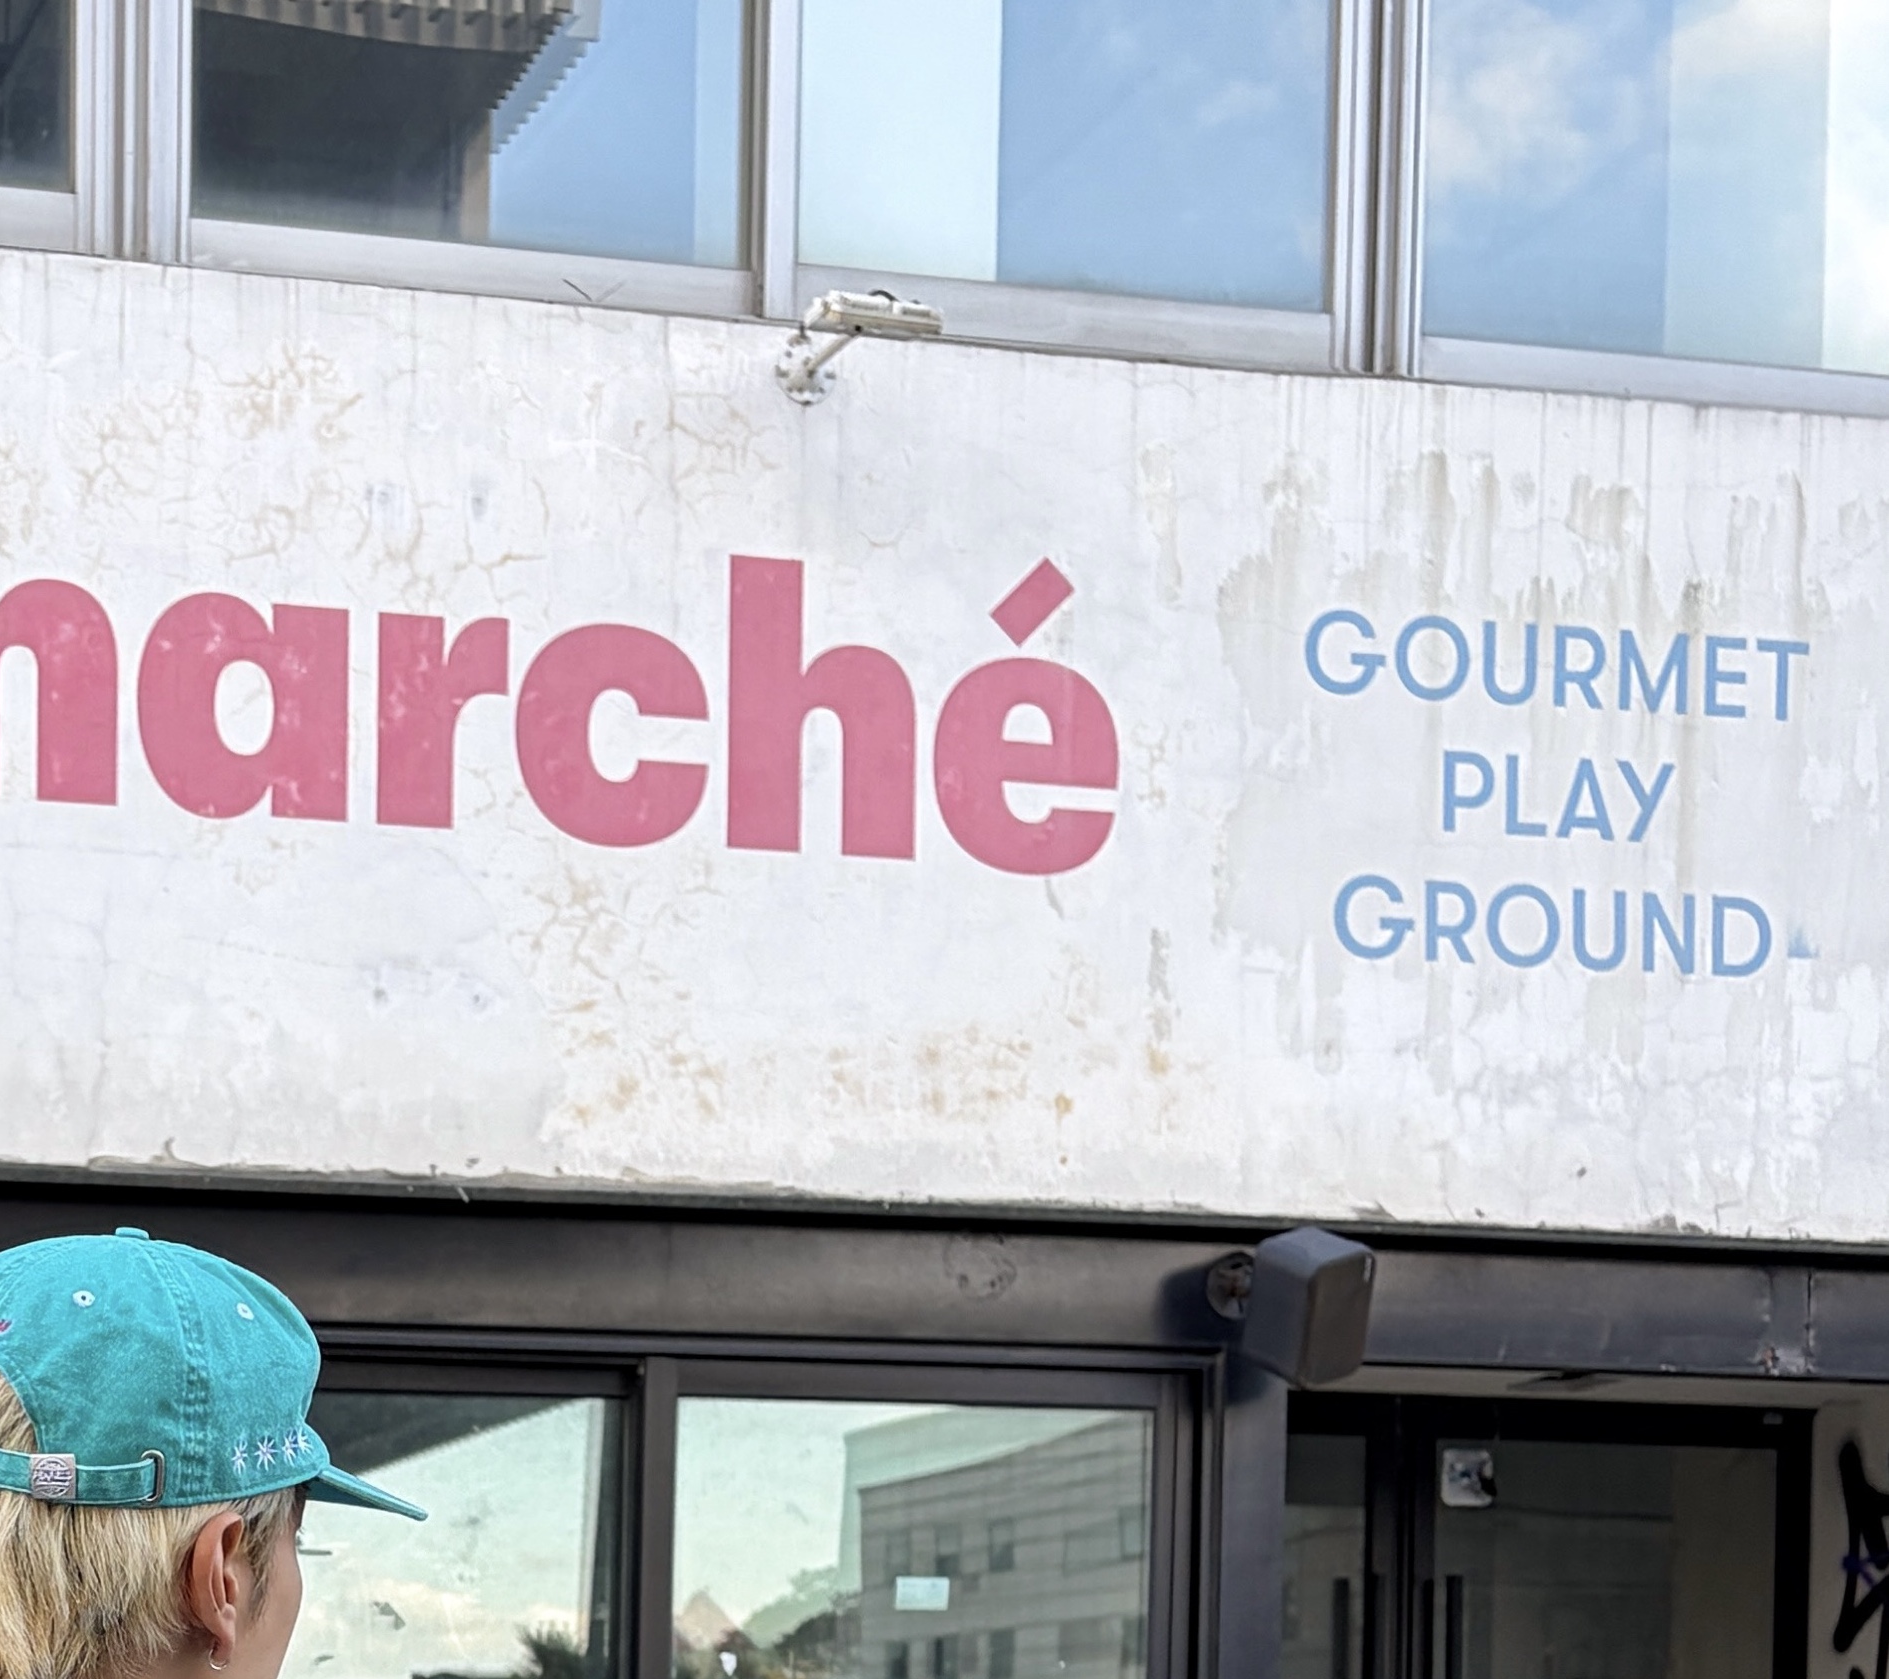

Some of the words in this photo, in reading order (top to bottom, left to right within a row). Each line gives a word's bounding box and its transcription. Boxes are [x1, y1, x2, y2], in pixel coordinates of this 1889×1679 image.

[1304, 608, 1810, 722] GOURMET
[1441, 750, 1676, 843] PLAY
[1333, 874, 1773, 978] GROUND
